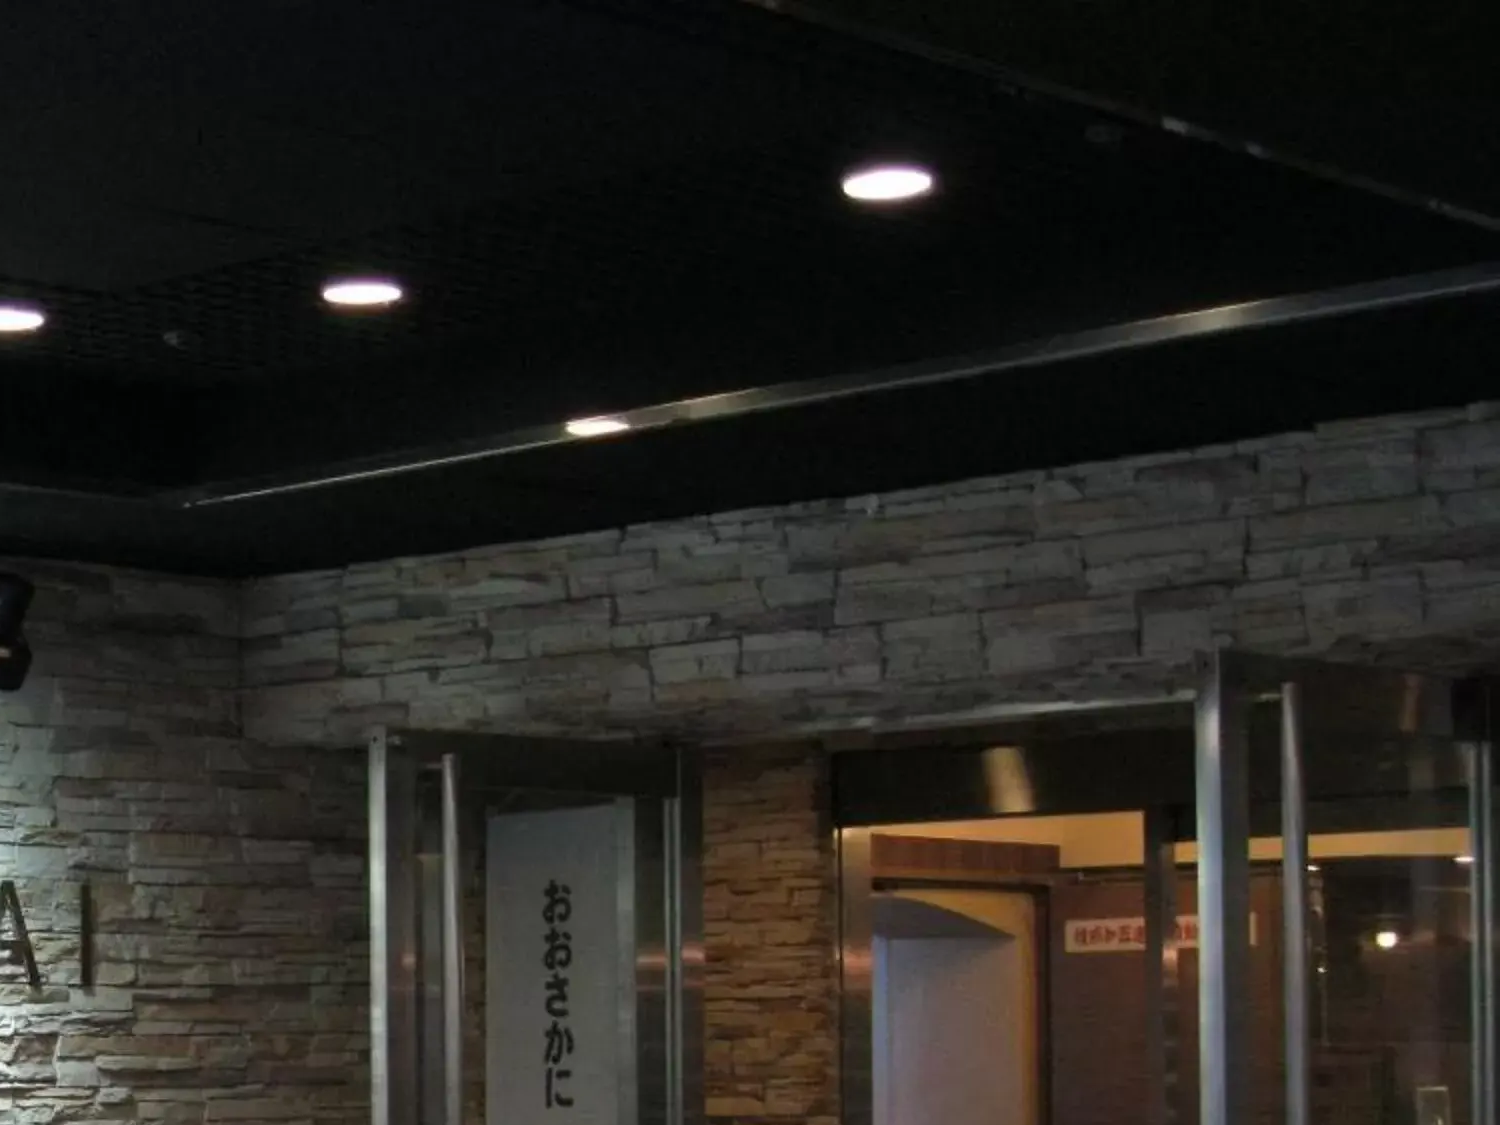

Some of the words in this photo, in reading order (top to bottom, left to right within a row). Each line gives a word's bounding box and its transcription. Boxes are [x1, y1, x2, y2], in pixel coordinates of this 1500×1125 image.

[542, 878, 575, 1110] おおさかに
